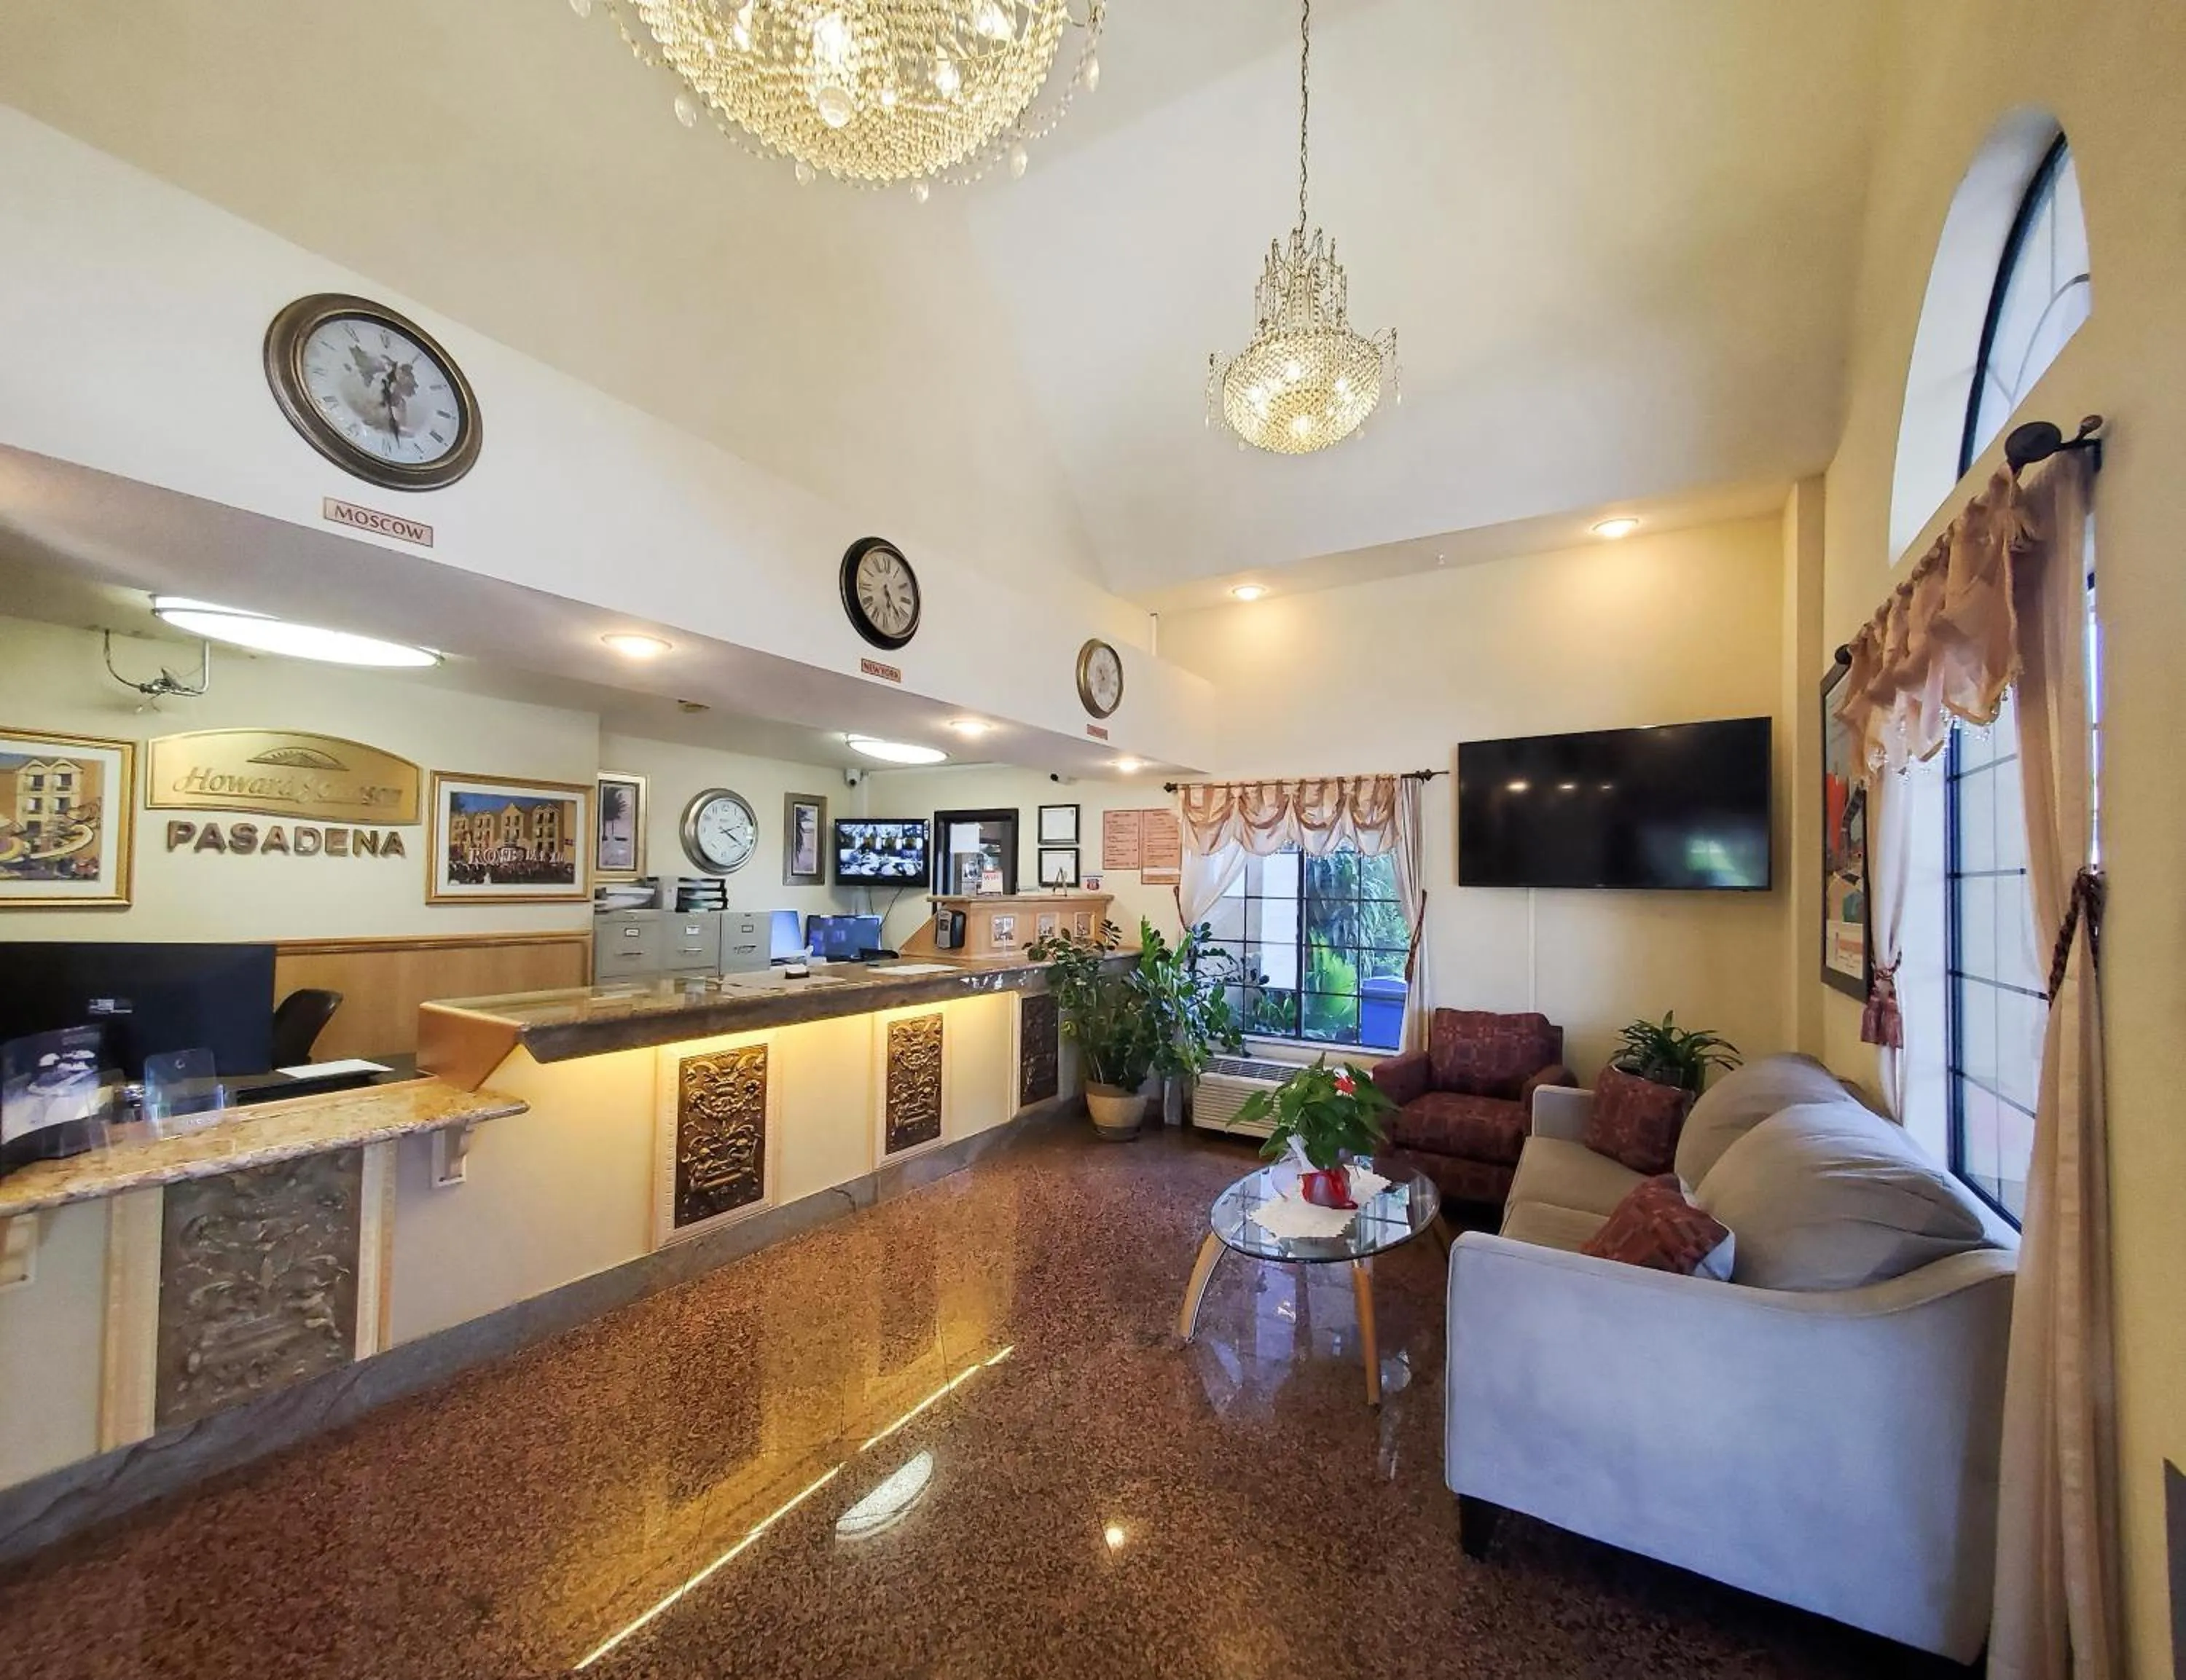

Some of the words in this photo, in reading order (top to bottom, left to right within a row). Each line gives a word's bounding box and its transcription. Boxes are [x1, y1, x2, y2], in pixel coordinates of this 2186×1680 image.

[334, 504, 423, 540] MOSCOW
[173, 766, 291, 799] Howard
[167, 820, 407, 858] PASADENA
